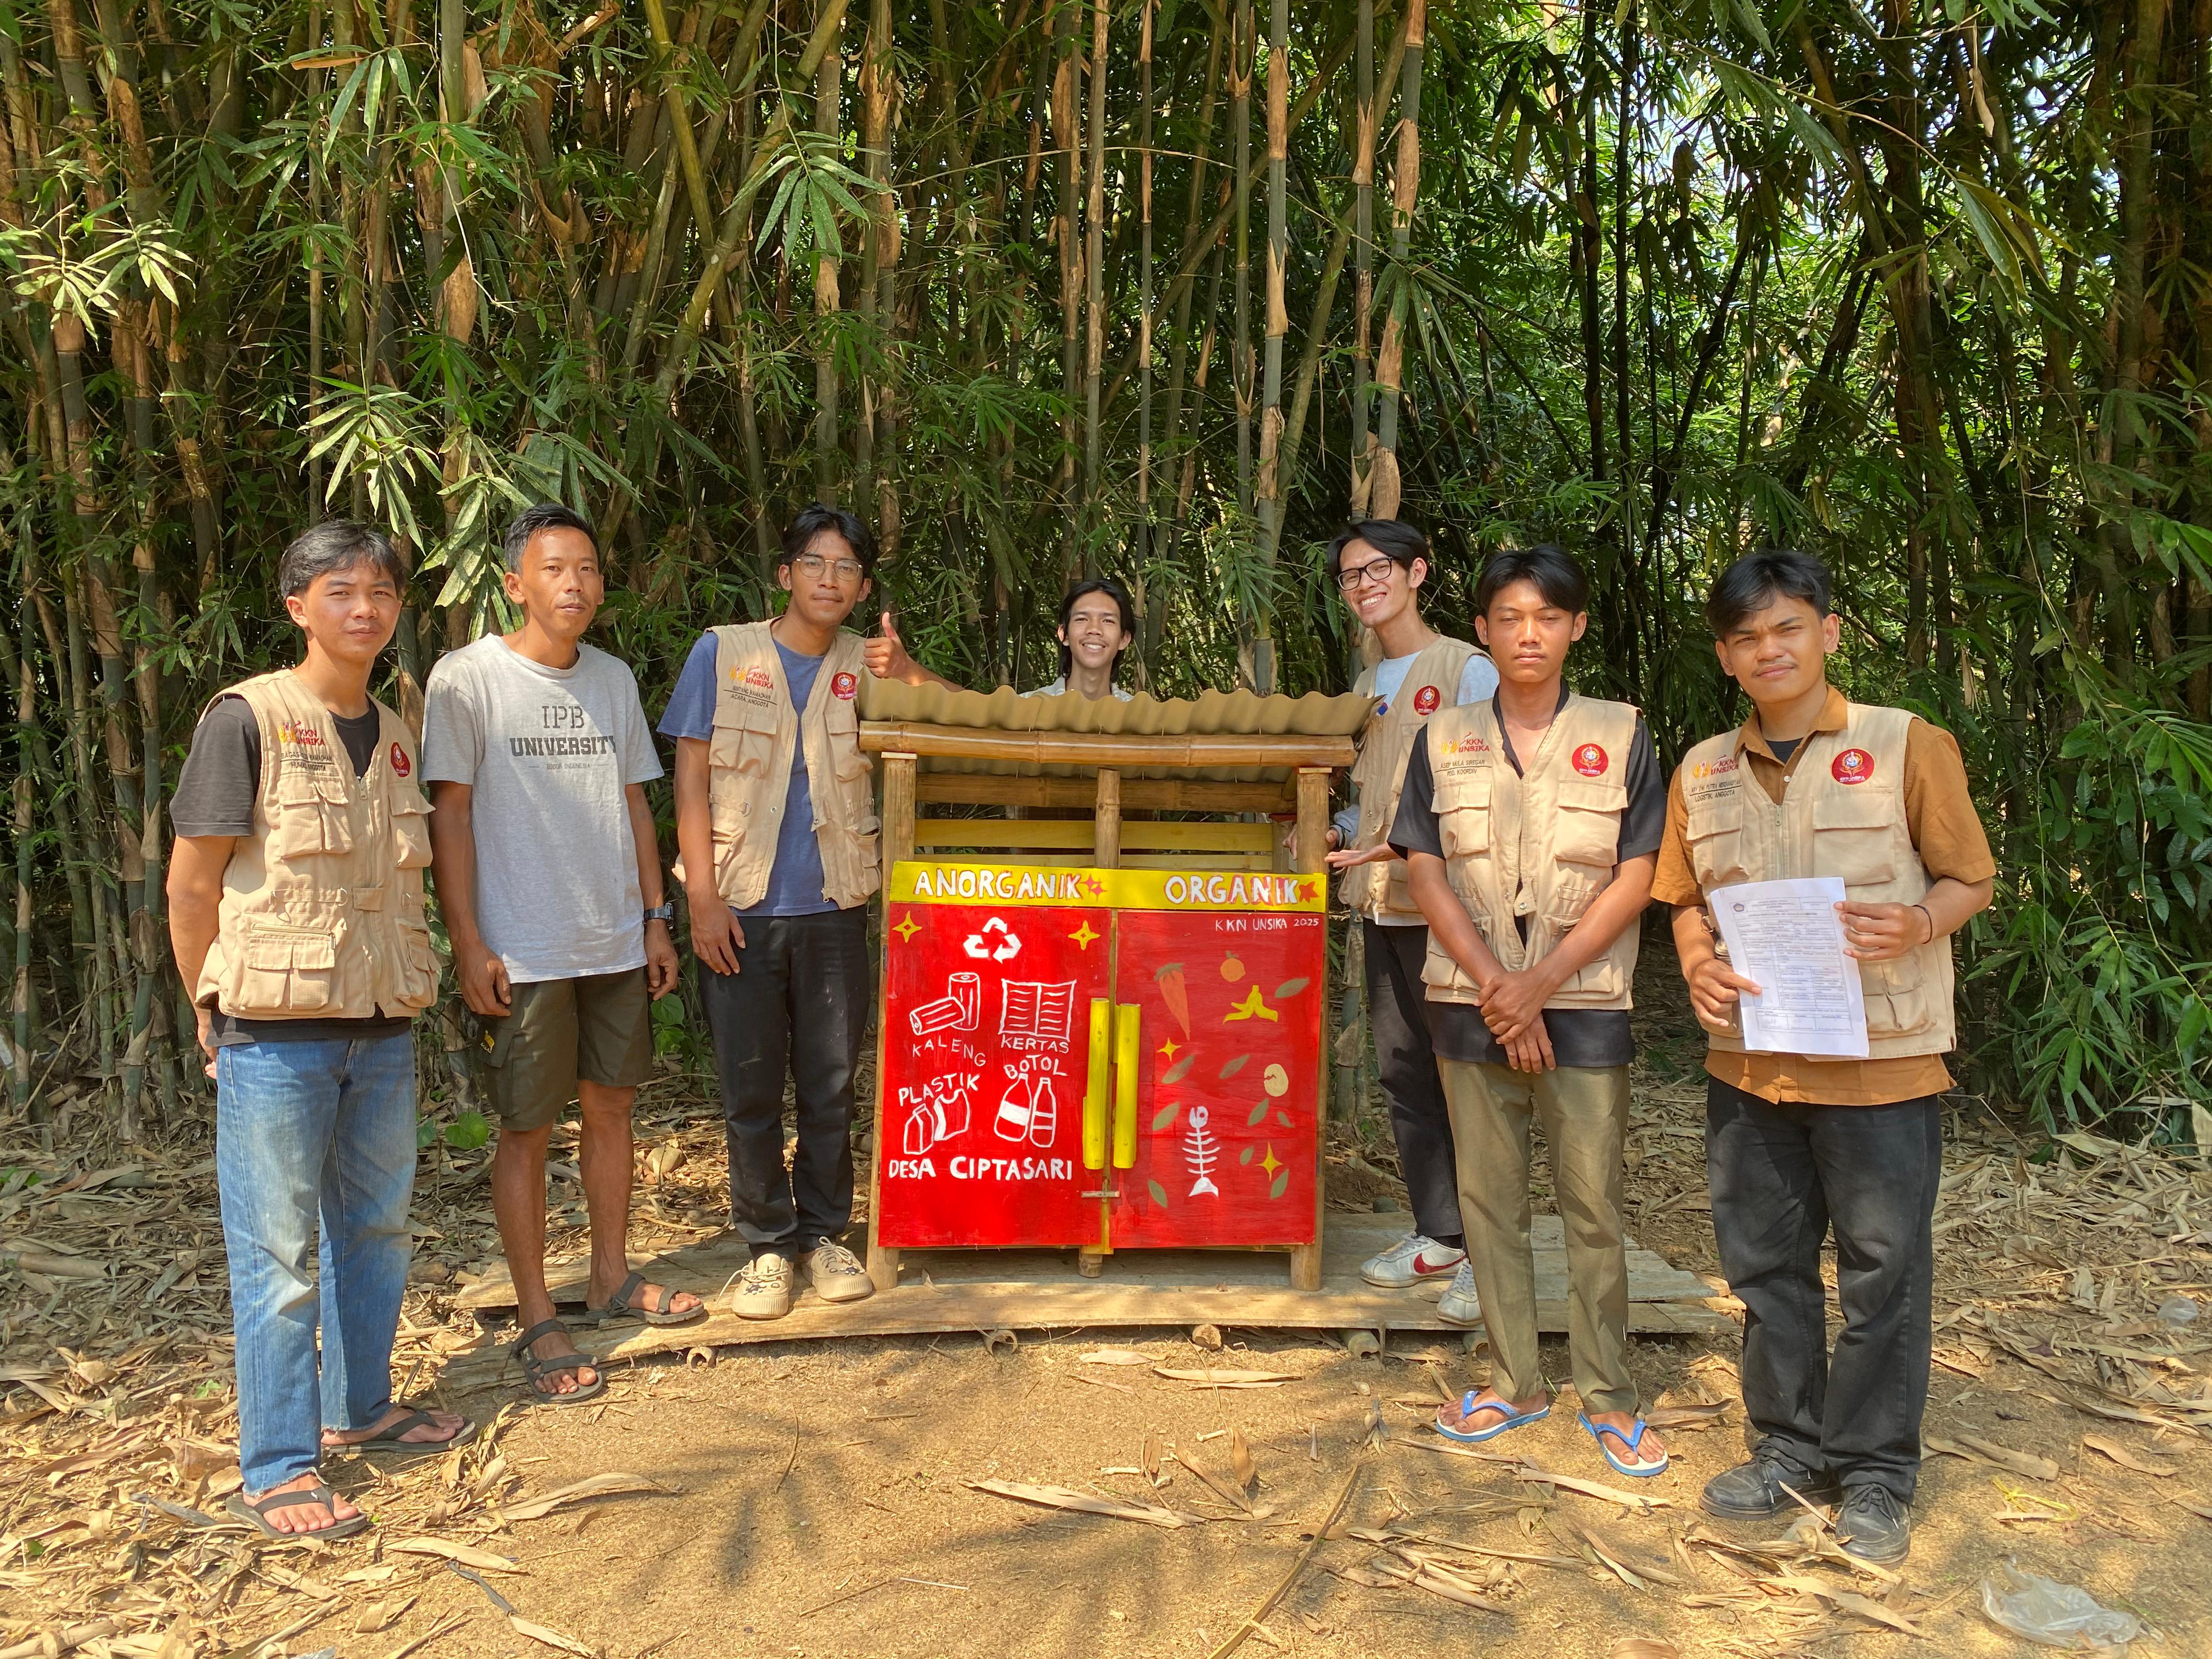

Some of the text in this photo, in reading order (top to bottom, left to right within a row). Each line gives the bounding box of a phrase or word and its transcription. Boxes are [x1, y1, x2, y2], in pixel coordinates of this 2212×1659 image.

[746, 678, 774, 690] UNSIKA
[753, 672, 770, 682] KKN
[542, 706, 585, 729] IPB
[296, 737, 325, 746] UNSIKA
[300, 729, 317, 738] KKN
[509, 735, 617, 757] UNIVERSITY
[1711, 764, 1739, 775] UNSIKA
[1719, 759, 1734, 767] KKN
[913, 868, 1081, 900] ANORGANIK
[1164, 874, 1300, 905] ORGANIK
[1215, 917, 1319, 932] KKN UNSIKA 2025
[912, 1035, 986, 1066] KALENG
[1001, 1034, 1070, 1054] KERTAS
[1003, 1054, 1069, 1079] BOTOL
[899, 1073, 980, 1107] PLASTIK
[888, 1156, 1073, 1180] DESA CIPTASARI
